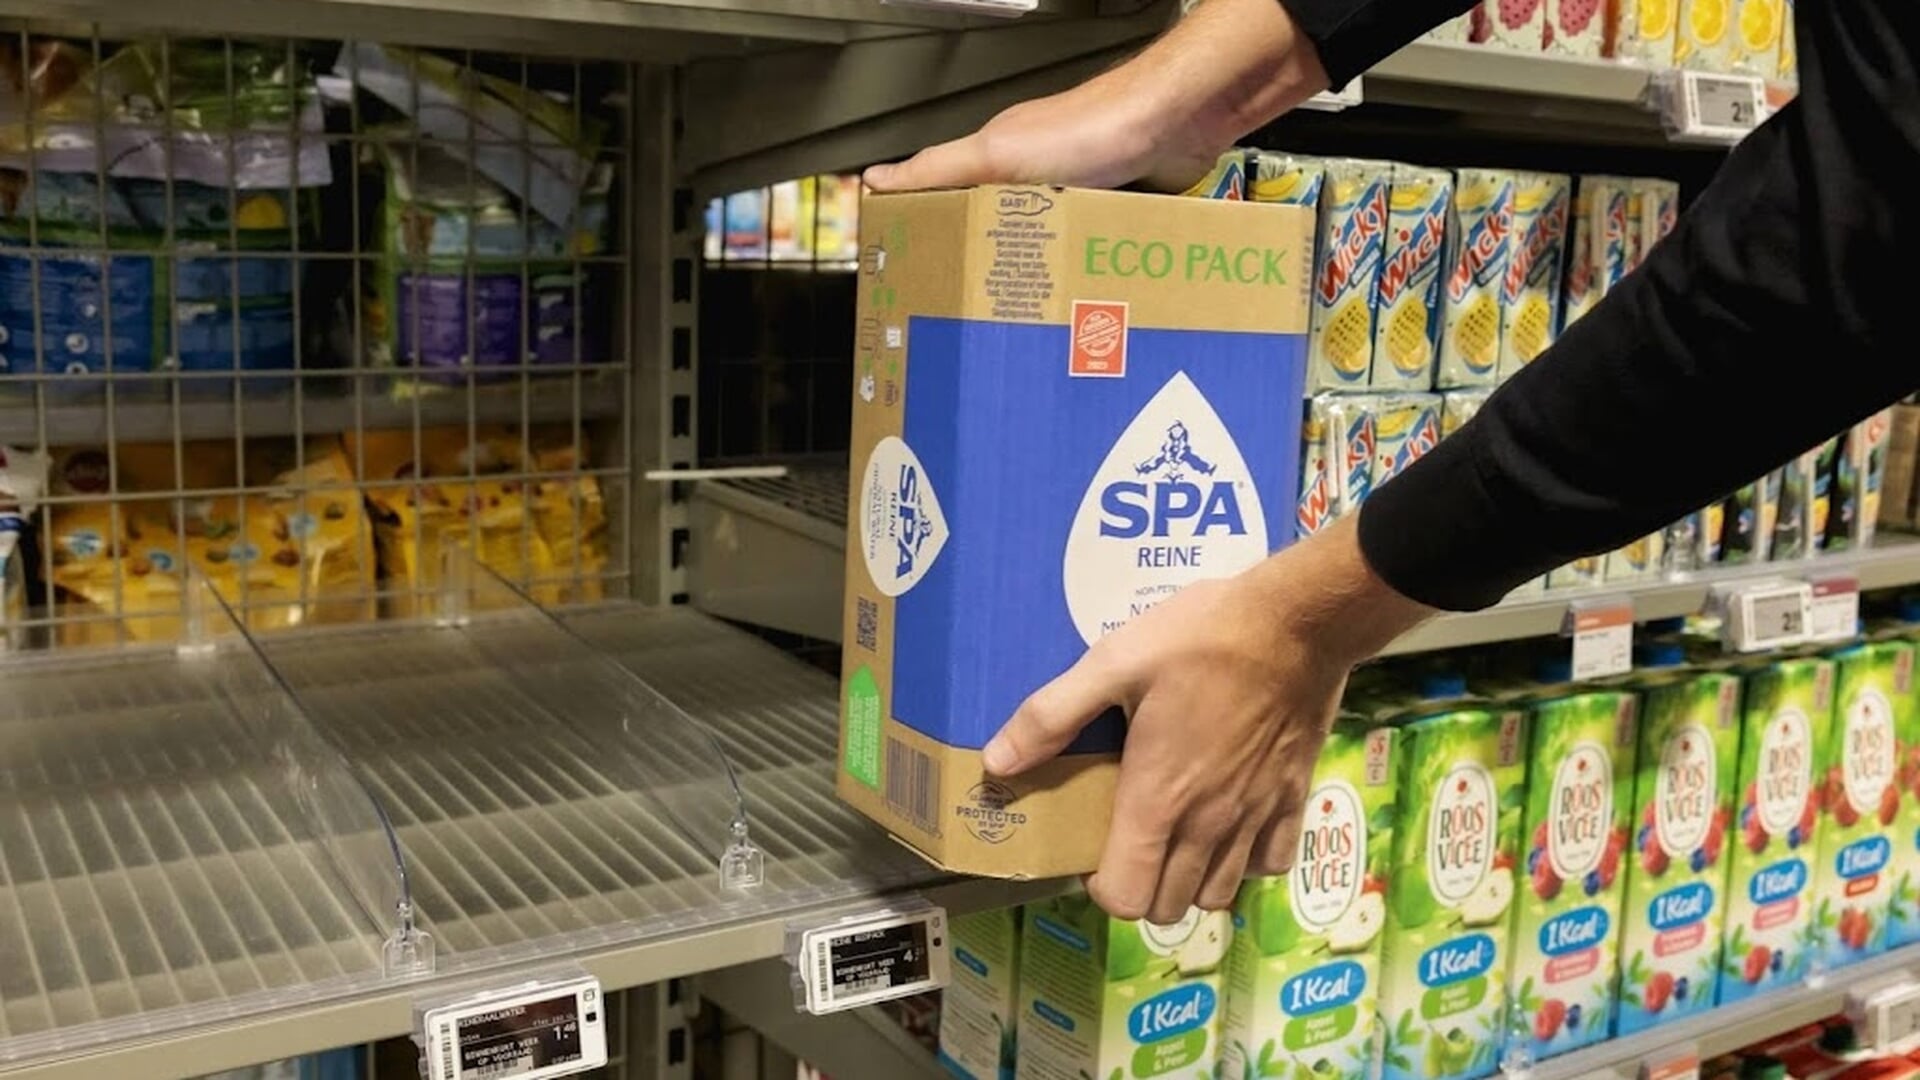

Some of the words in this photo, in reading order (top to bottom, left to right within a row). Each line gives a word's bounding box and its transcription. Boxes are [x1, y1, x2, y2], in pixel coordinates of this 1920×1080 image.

[1085, 237, 1173, 278] ECO
[1185, 243, 1288, 285] PACK
[1317, 182, 1387, 303] Wicky
[1378, 212, 1446, 303] Wick
[896, 463, 917, 579] SPA
[1099, 481, 1248, 539] SPA
[1137, 546, 1202, 568] REINE
[956, 805, 1027, 825] PROTECTED
[1440, 801, 1484, 839] ROOS
[1303, 822, 1353, 863] ROOS
[465, 1041, 515, 1061] BINNENKORT
[492, 1048, 533, 1063] VOORRAAD
